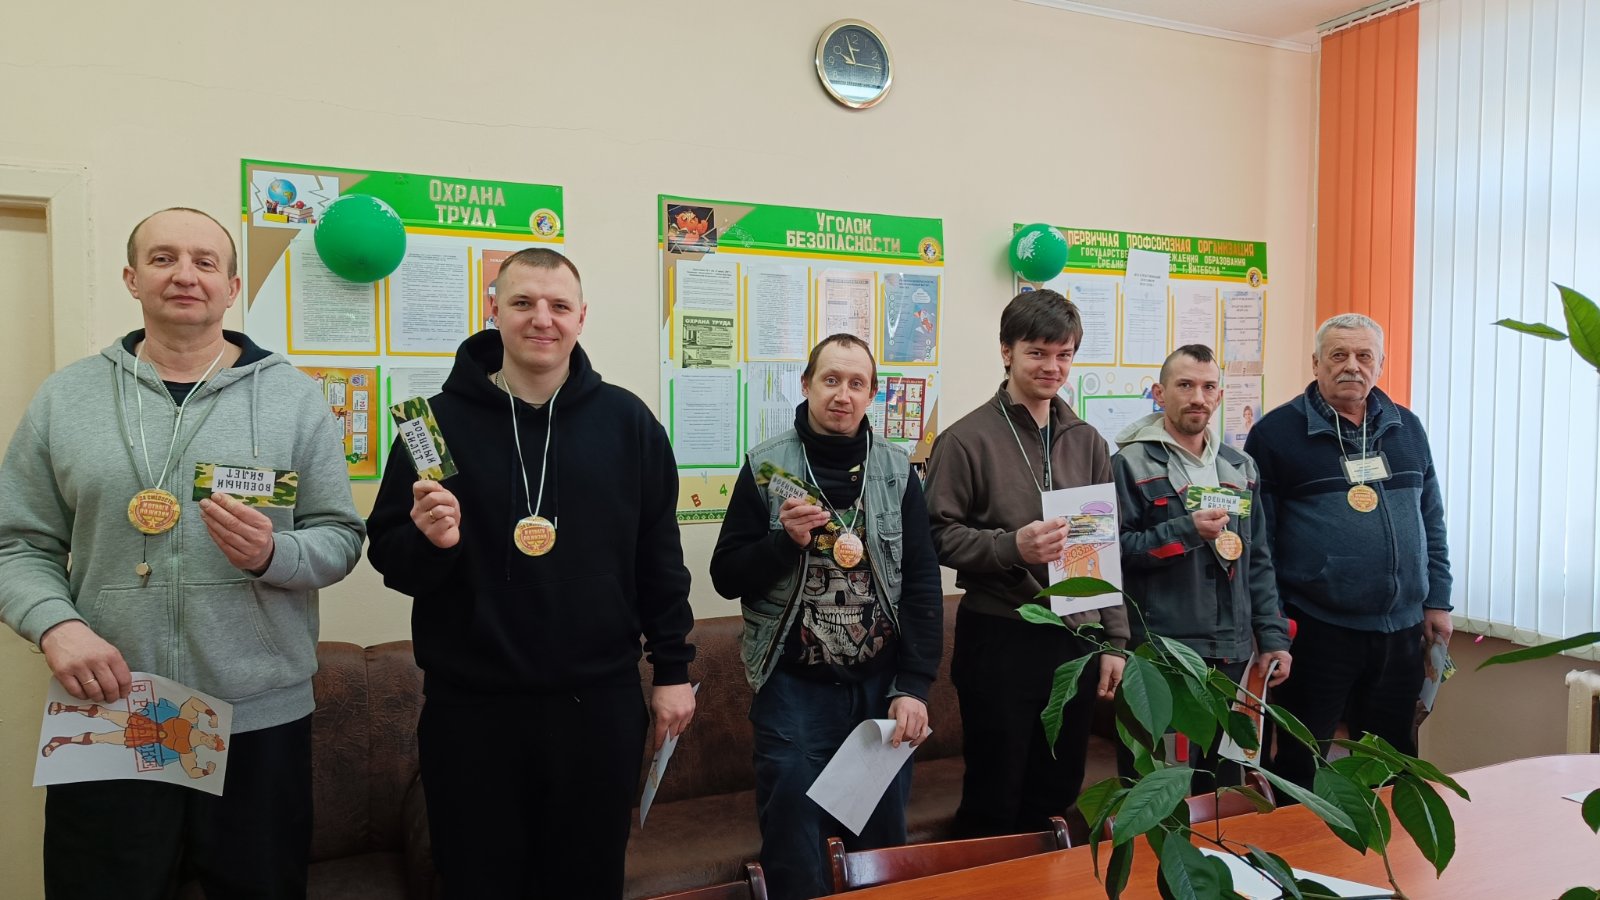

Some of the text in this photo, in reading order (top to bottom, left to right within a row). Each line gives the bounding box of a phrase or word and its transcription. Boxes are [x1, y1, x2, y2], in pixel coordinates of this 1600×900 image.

[429, 178, 505, 206] ОХРАНА
[434, 204, 497, 228] ТРУДА
[816, 211, 872, 235] УГОЛОК
[786, 230, 900, 254] БЕЗОПАСНОСТИ
[1067, 229, 1254, 256] ПЕРВИЧНАЯ ПРОФСОЮЗНАЯ ОРГАНИЗАЦИЯ
[1080, 246, 1128, 259] ГОСУДАРСТВЕ
[1203, 255, 1246, 266] ОБРАЗОВАНИЯ
[685, 317, 732, 327] ОХРАНА ТРУДА
[405, 431, 424, 461] БИЛЕТ
[226, 468, 264, 482] БИЛЕТ
[720, 484, 728, 497] 4
[131, 684, 147, 693] В
